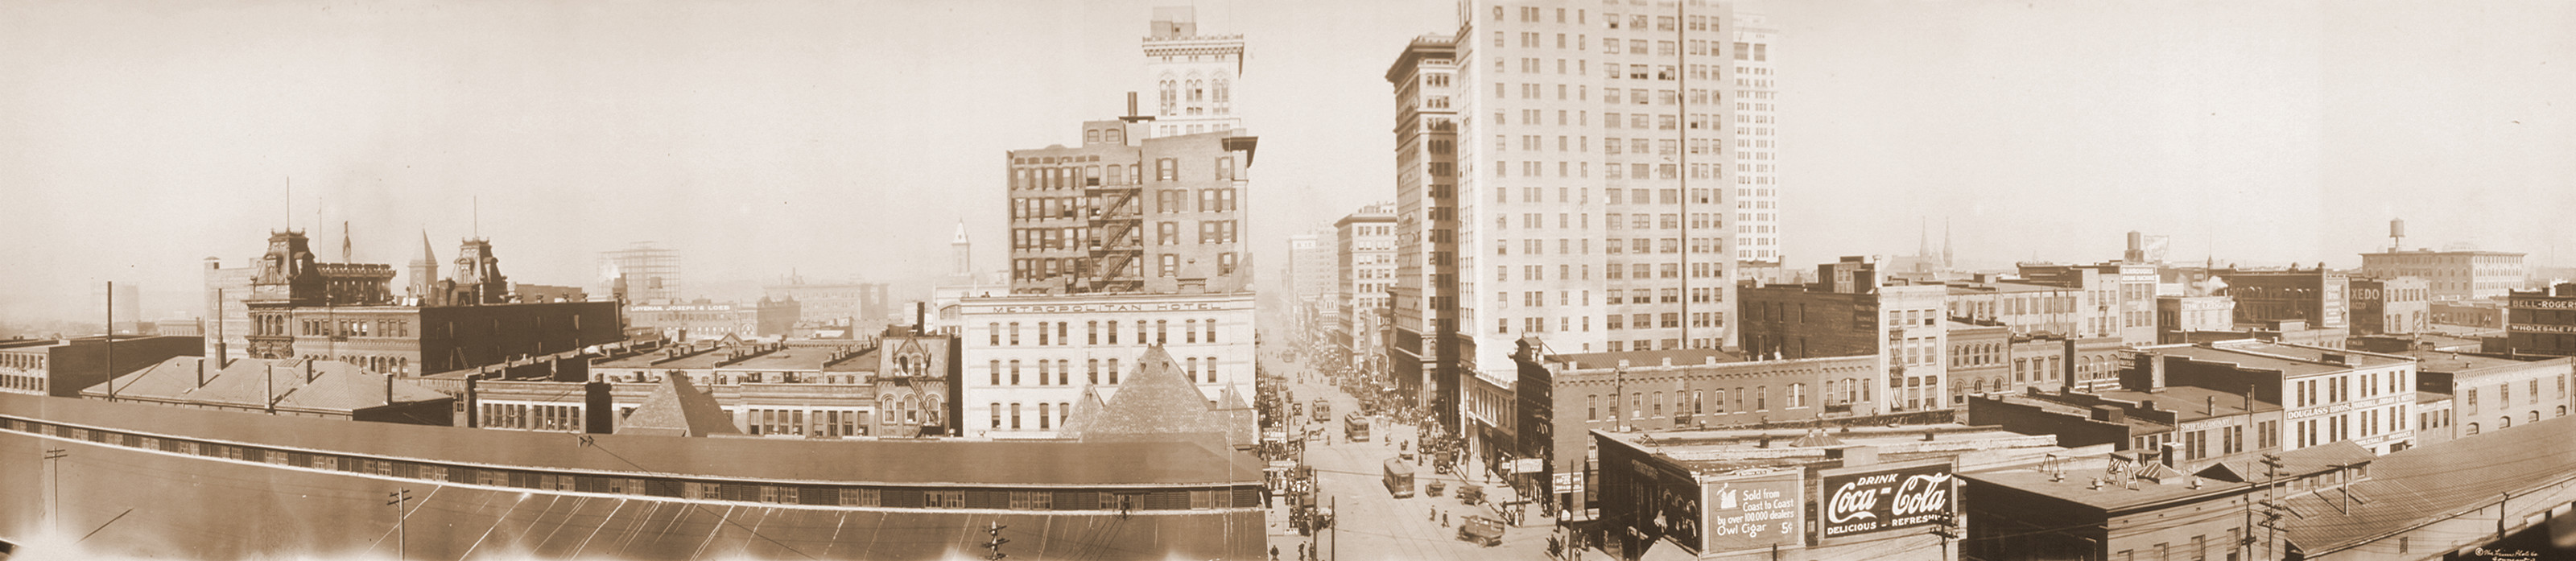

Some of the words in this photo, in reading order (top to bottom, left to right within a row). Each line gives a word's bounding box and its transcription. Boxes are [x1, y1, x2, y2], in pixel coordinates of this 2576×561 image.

[2351, 288, 2380, 299] XEDO
[993, 303, 1142, 313] METROPOLITAN
[1157, 303, 1221, 311] HOTEL
[2288, 406, 2329, 419] DOUGLASS
[2330, 403, 2352, 413] BROS.
[1856, 473, 1899, 486] DRINK
[1743, 489, 1761, 501] Sold
[1763, 488, 1780, 498] from
[1743, 501, 1763, 512] Coast
[1765, 501, 1772, 509] to
[1773, 498, 1794, 509] Coast
[1717, 515, 1726, 526] by
[1728, 516, 1744, 524] over
[1769, 509, 1794, 519] dealers
[1717, 524, 1738, 536] Owl
[1741, 523, 1767, 538] Cigar
[1781, 522, 1793, 534] 5¢
[1827, 522, 1876, 535] DELICIOUS
